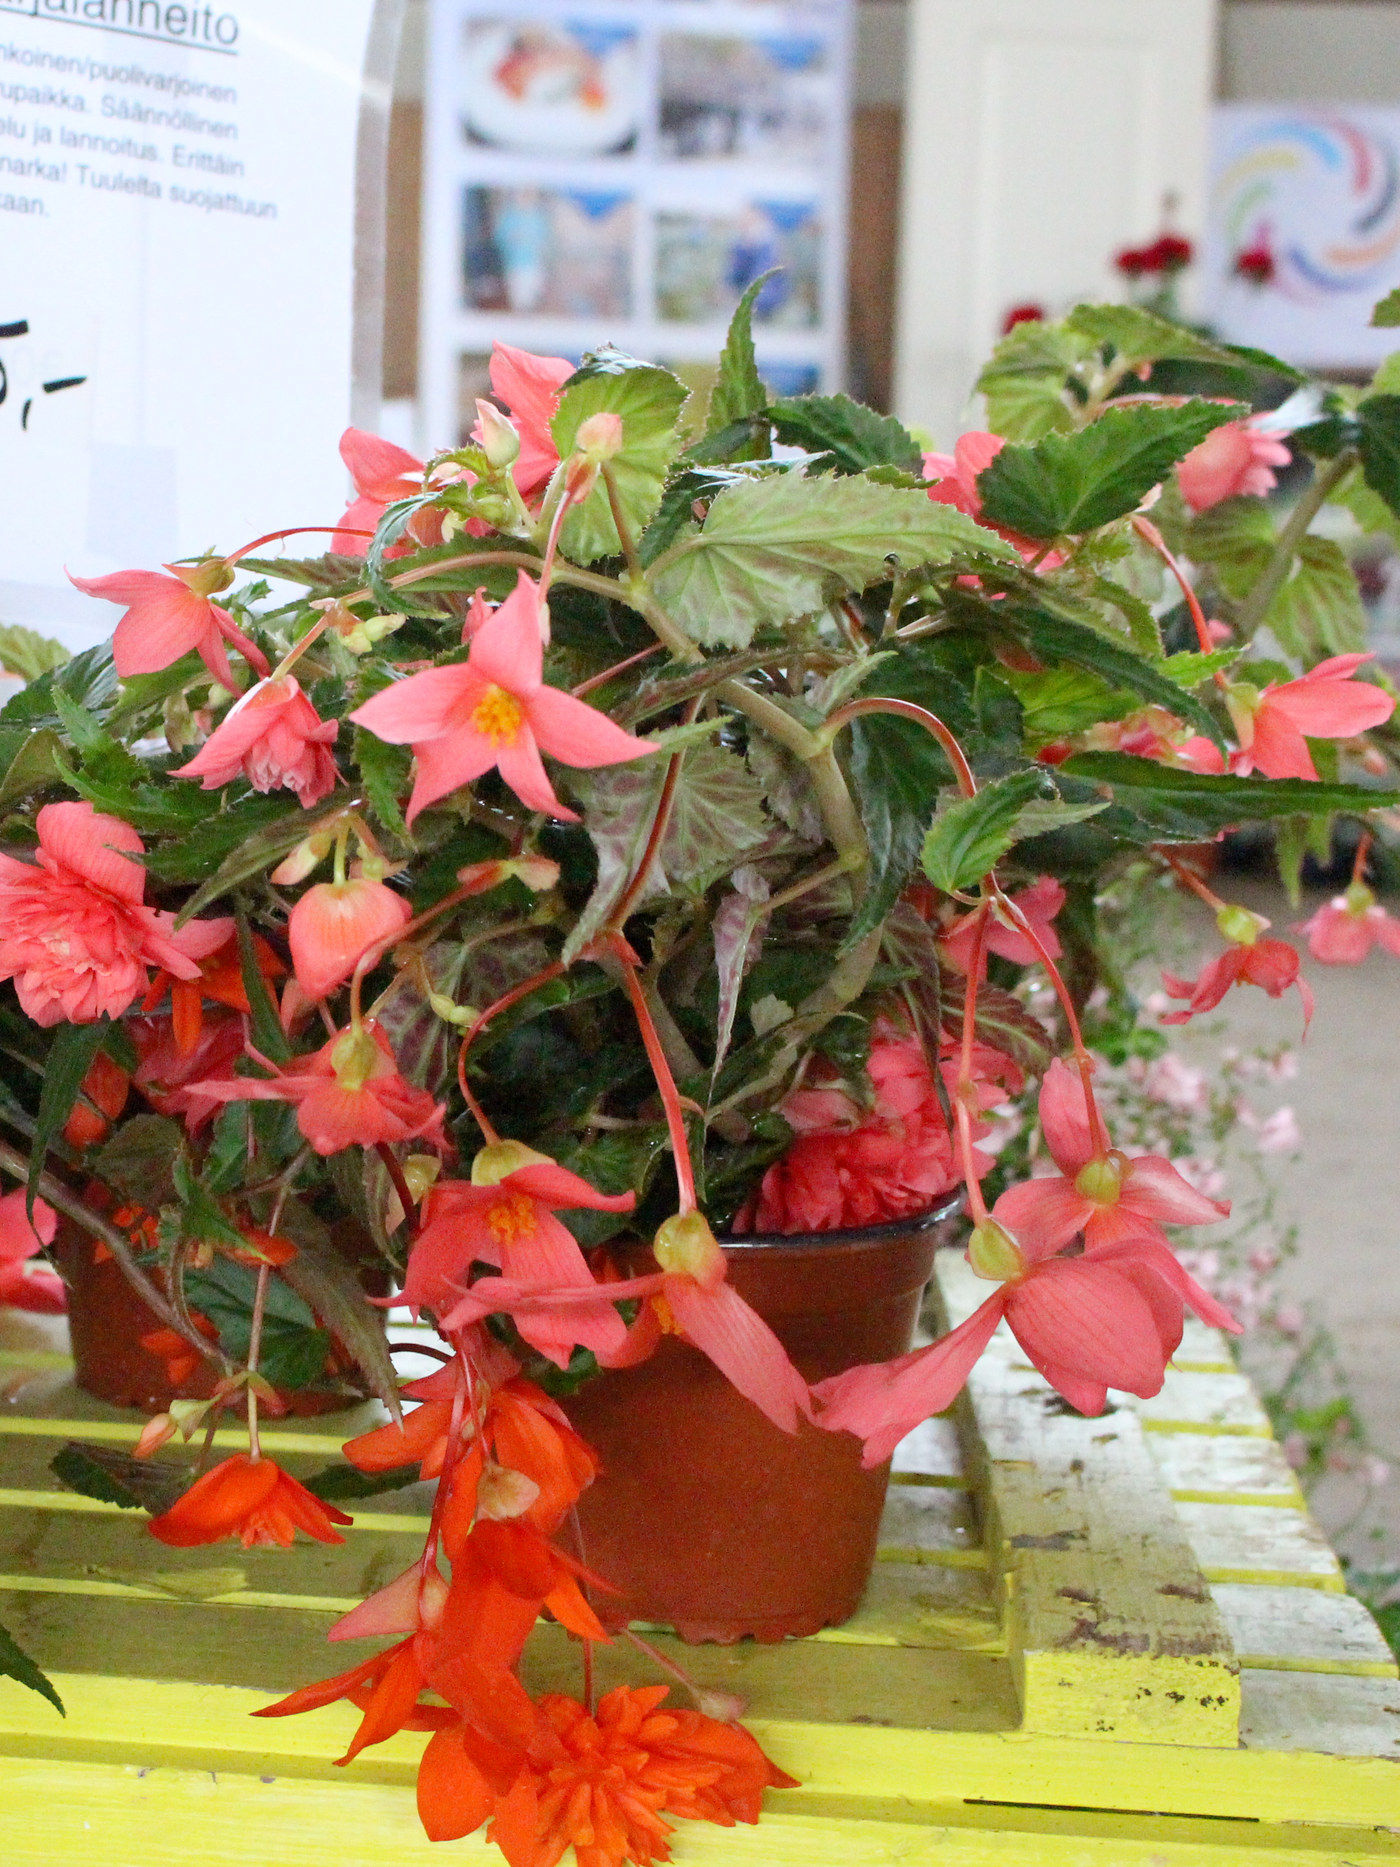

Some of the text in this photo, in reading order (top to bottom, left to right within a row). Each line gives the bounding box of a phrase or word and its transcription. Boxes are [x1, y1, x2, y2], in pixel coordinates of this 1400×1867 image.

[100, 94, 240, 141] Säännöllinen
[32, 120, 53, 147] ja
[59, 125, 163, 164] lannoitus.
[171, 144, 246, 178] Erittäin
[76, 165, 162, 201] Tuulelta
[168, 184, 278, 220] suojattuun
